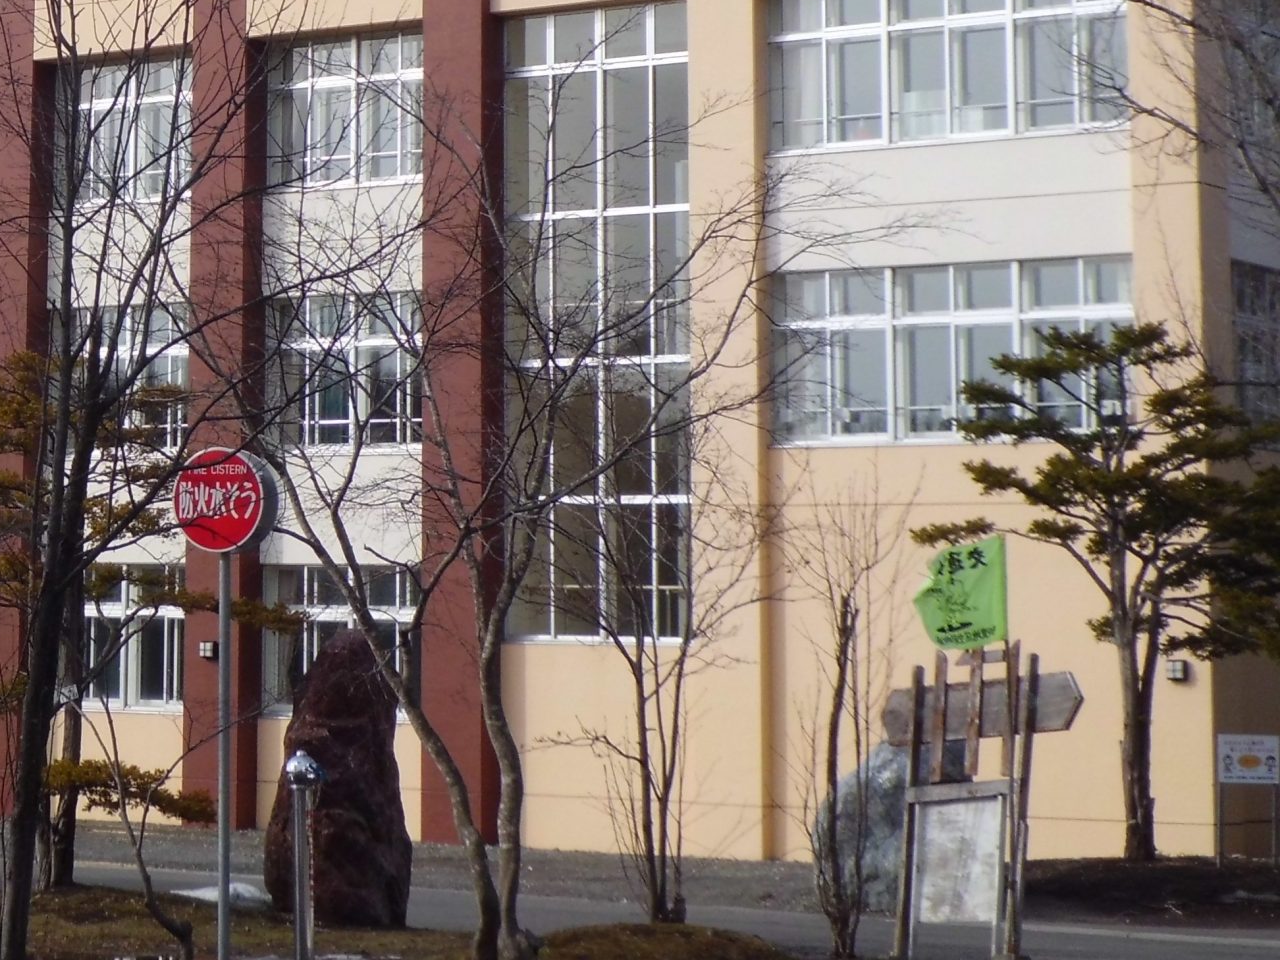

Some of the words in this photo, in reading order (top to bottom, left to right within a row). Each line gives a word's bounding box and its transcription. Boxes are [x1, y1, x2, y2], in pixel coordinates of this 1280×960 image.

[210, 464, 247, 475] CISTERN
[178, 481, 257, 520] 防火水そう
